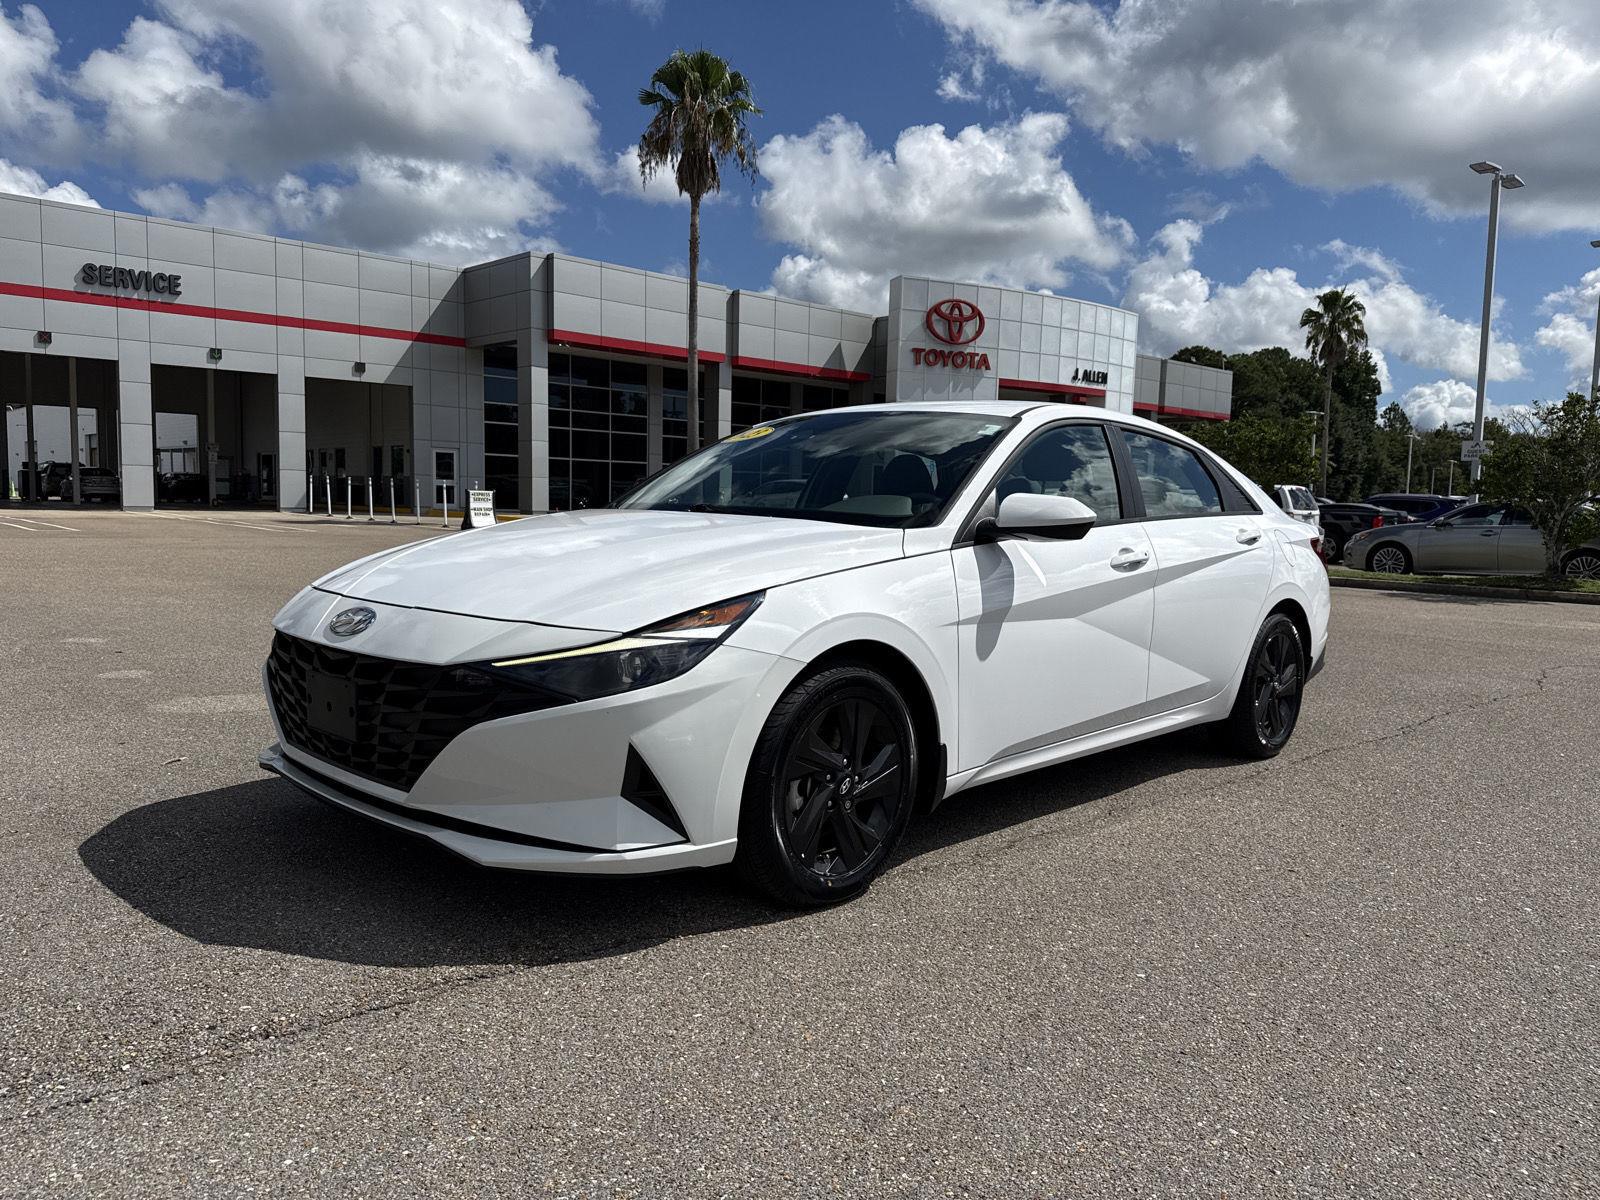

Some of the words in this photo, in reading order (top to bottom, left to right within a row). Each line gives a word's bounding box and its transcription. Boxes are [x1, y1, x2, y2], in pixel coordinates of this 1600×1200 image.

[82, 263, 182, 295] SERVICE
[912, 347, 991, 370] TOYOTA
[1071, 368, 1081, 382] J.
[1082, 369, 1108, 385] ALLEN
